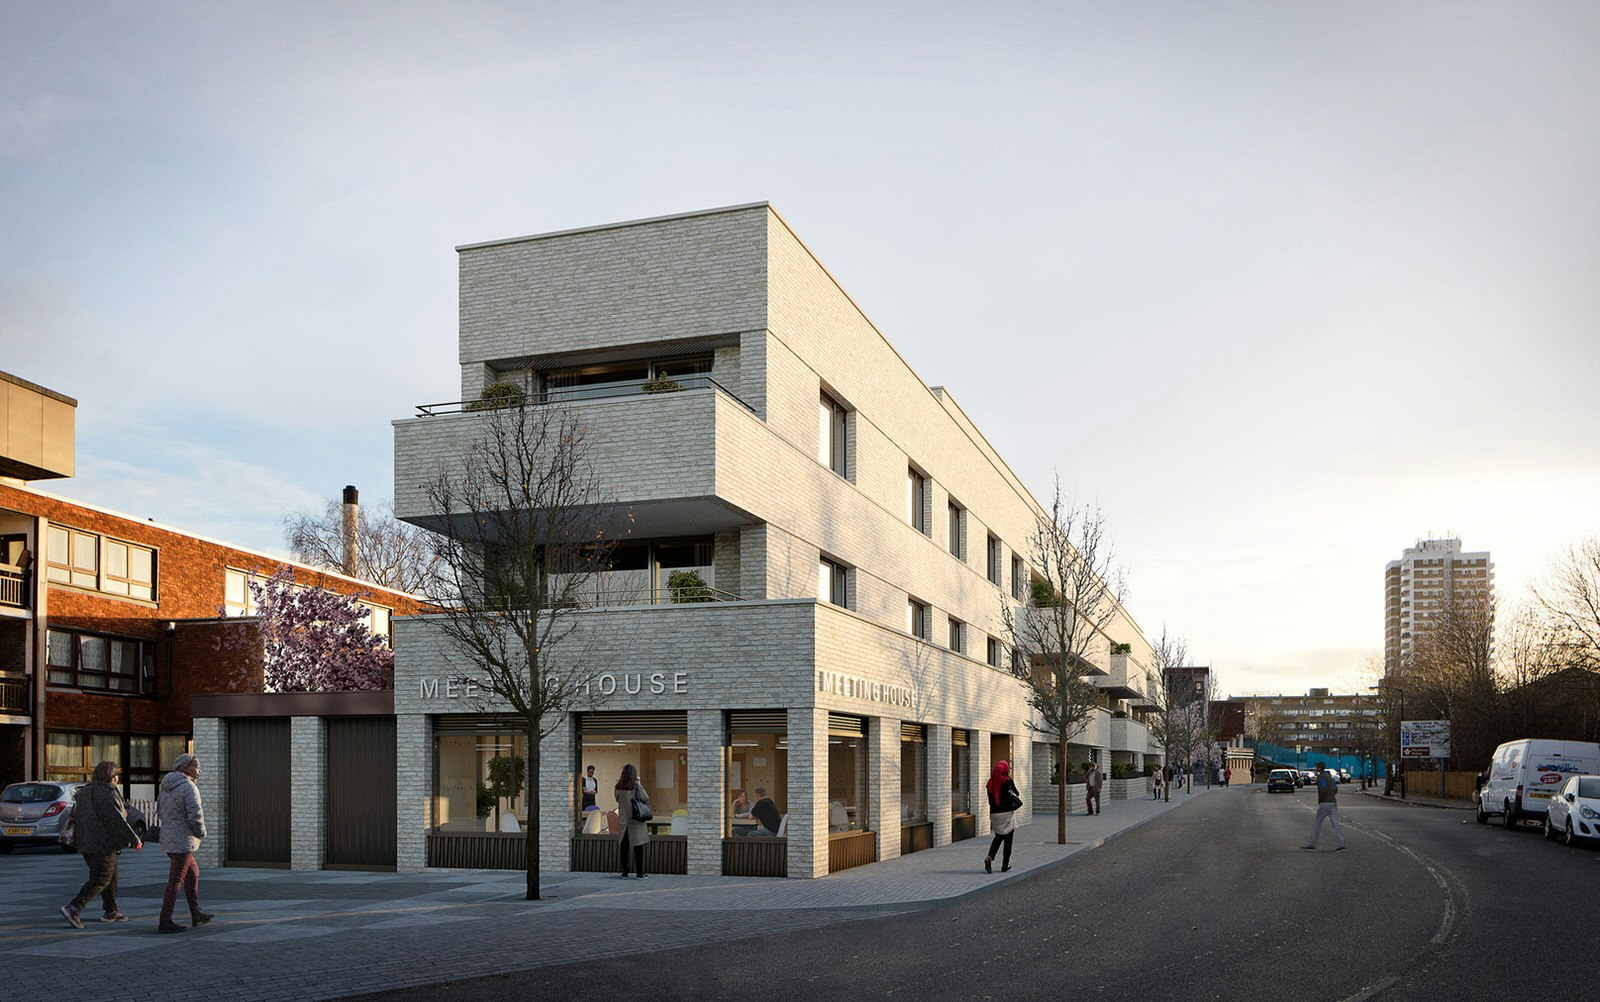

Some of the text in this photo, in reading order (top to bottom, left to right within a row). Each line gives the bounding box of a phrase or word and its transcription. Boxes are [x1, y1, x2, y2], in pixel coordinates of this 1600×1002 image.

[576, 672, 688, 695] HOUSE
[822, 671, 918, 708] MEETING HOUSE
